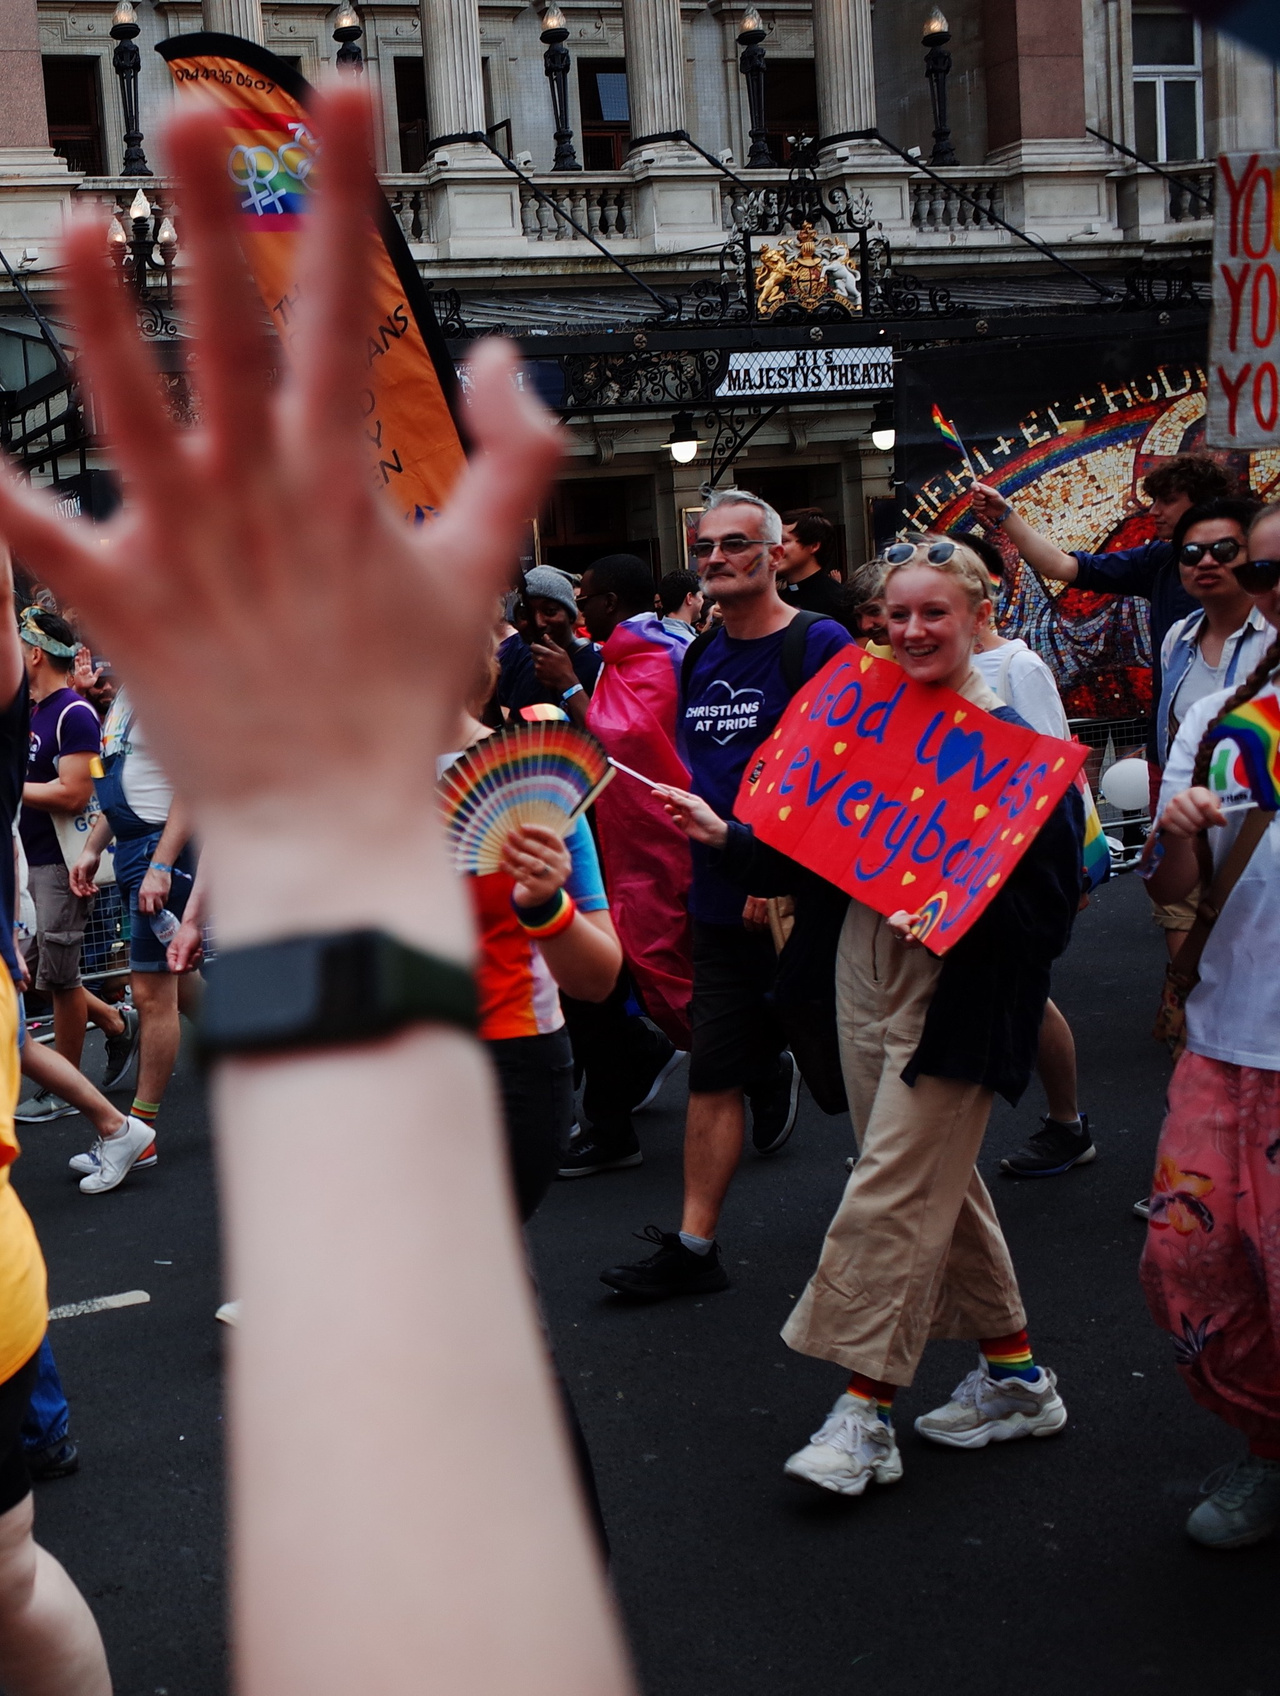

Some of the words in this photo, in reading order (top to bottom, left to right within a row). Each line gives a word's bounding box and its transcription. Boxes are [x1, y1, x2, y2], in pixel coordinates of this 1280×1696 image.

[236, 72, 275, 94] 0507
[1218, 154, 1280, 259] YO
[1221, 263, 1280, 352] YO
[796, 351, 833, 366] HIS
[827, 361, 894, 385] THEATR
[686, 701, 759, 718] CHRISTIANS
[809, 663, 907, 744] God
[695, 720, 713, 731] AT
[717, 716, 757, 731] PRIDE
[779, 745, 1001, 933] everybody
